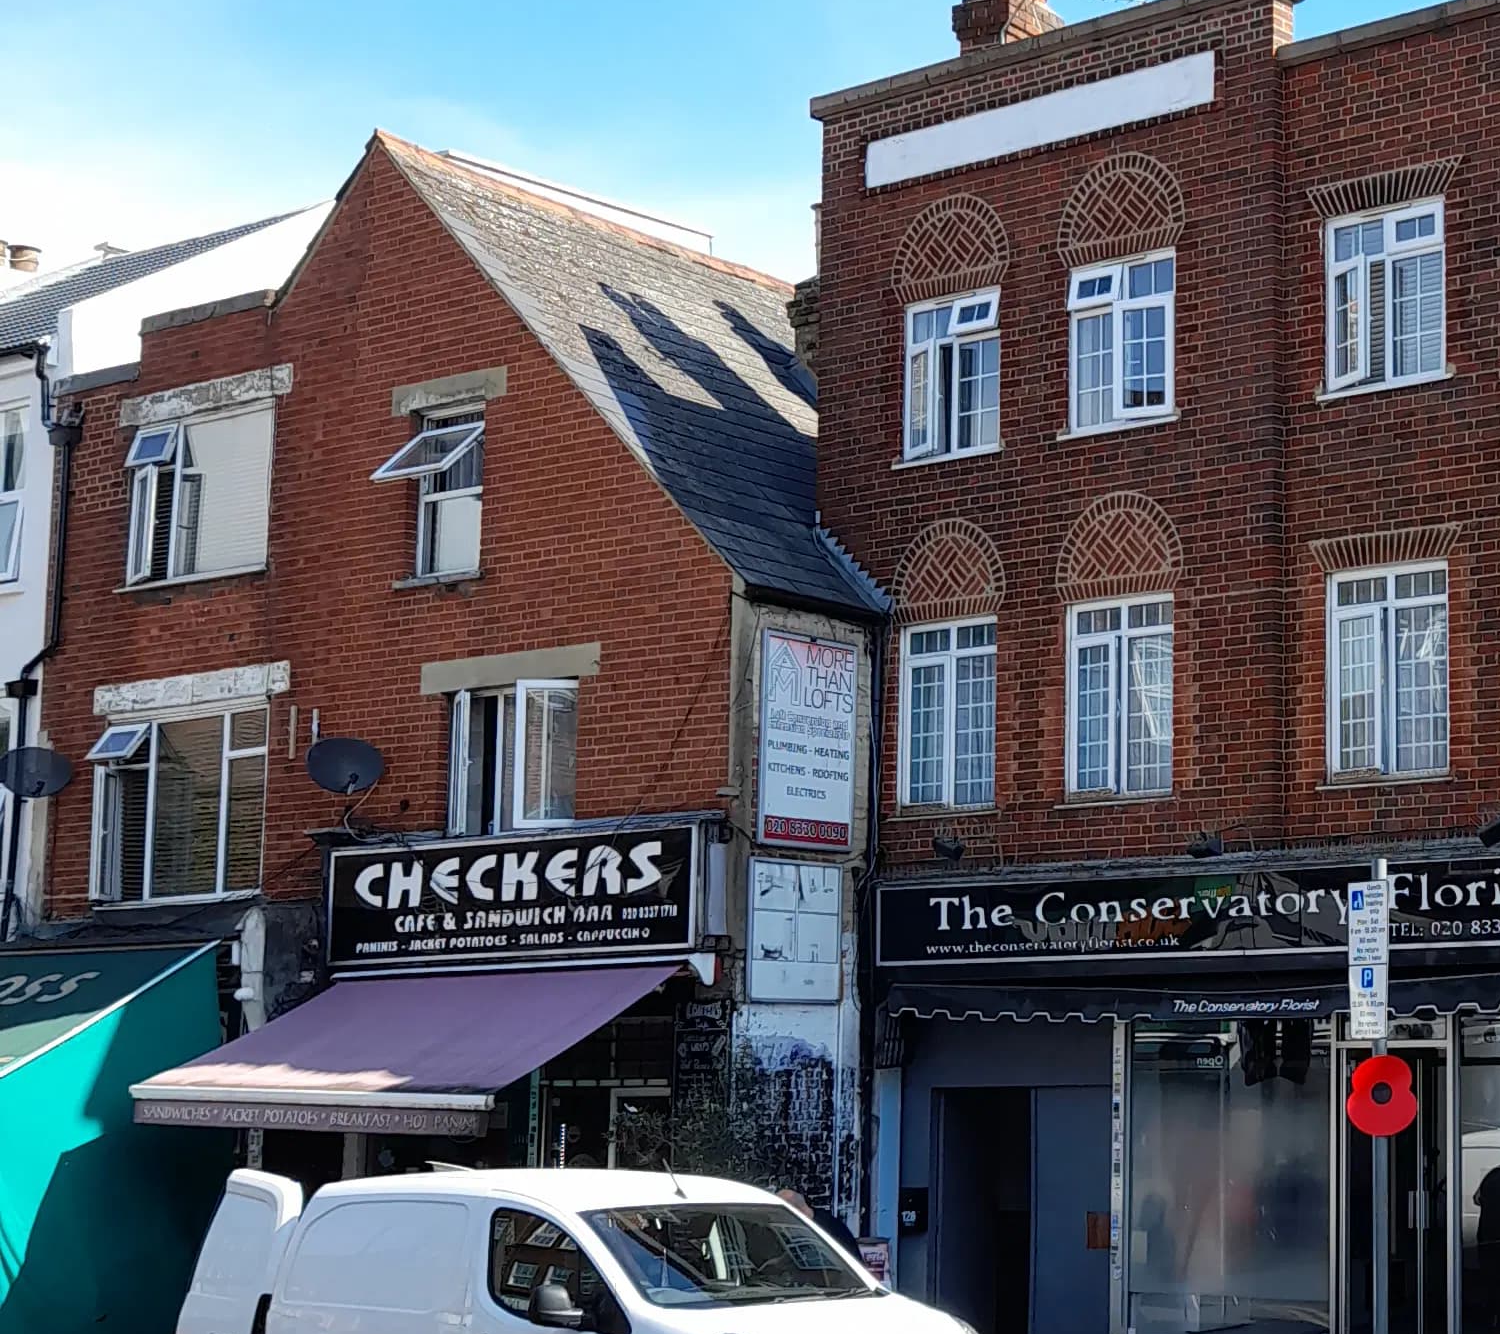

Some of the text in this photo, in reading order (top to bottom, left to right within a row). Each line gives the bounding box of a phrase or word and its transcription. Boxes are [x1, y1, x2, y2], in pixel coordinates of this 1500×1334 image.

[807, 645, 854, 672] MORE
[806, 666, 852, 692] THAN
[804, 686, 854, 714] LOFTS
[768, 739, 808, 754] PLUMBING
[814, 747, 850, 760] HEATING
[768, 762, 806, 776] KITCHENS
[812, 768, 849, 782] ROOFING
[786, 786, 827, 799] ELECTRICS
[766, 818, 787, 834] 020
[819, 824, 847, 840] 0090
[354, 840, 662, 909] CHECKERS
[394, 914, 436, 933] CAFE
[443, 912, 457, 931] &
[463, 906, 566, 930] SANDWICH
[573, 904, 613, 923] BAR
[929, 895, 1015, 931] The
[1036, 888, 1348, 927] Conservatory
[408, 937, 447, 951] JACKET
[449, 935, 508, 949] POTATOES
[519, 932, 564, 945] SALADS
[576, 927, 650, 942] CAPPUCCINO
[1389, 922, 1424, 937] TEL:
[1431, 921, 1463, 936] 020
[926, 934, 1180, 954] www.theconservatoryflorist.co.uk
[1364, 969, 1372, 987] P
[1172, 998, 1320, 1013] The Conservatory Florist
